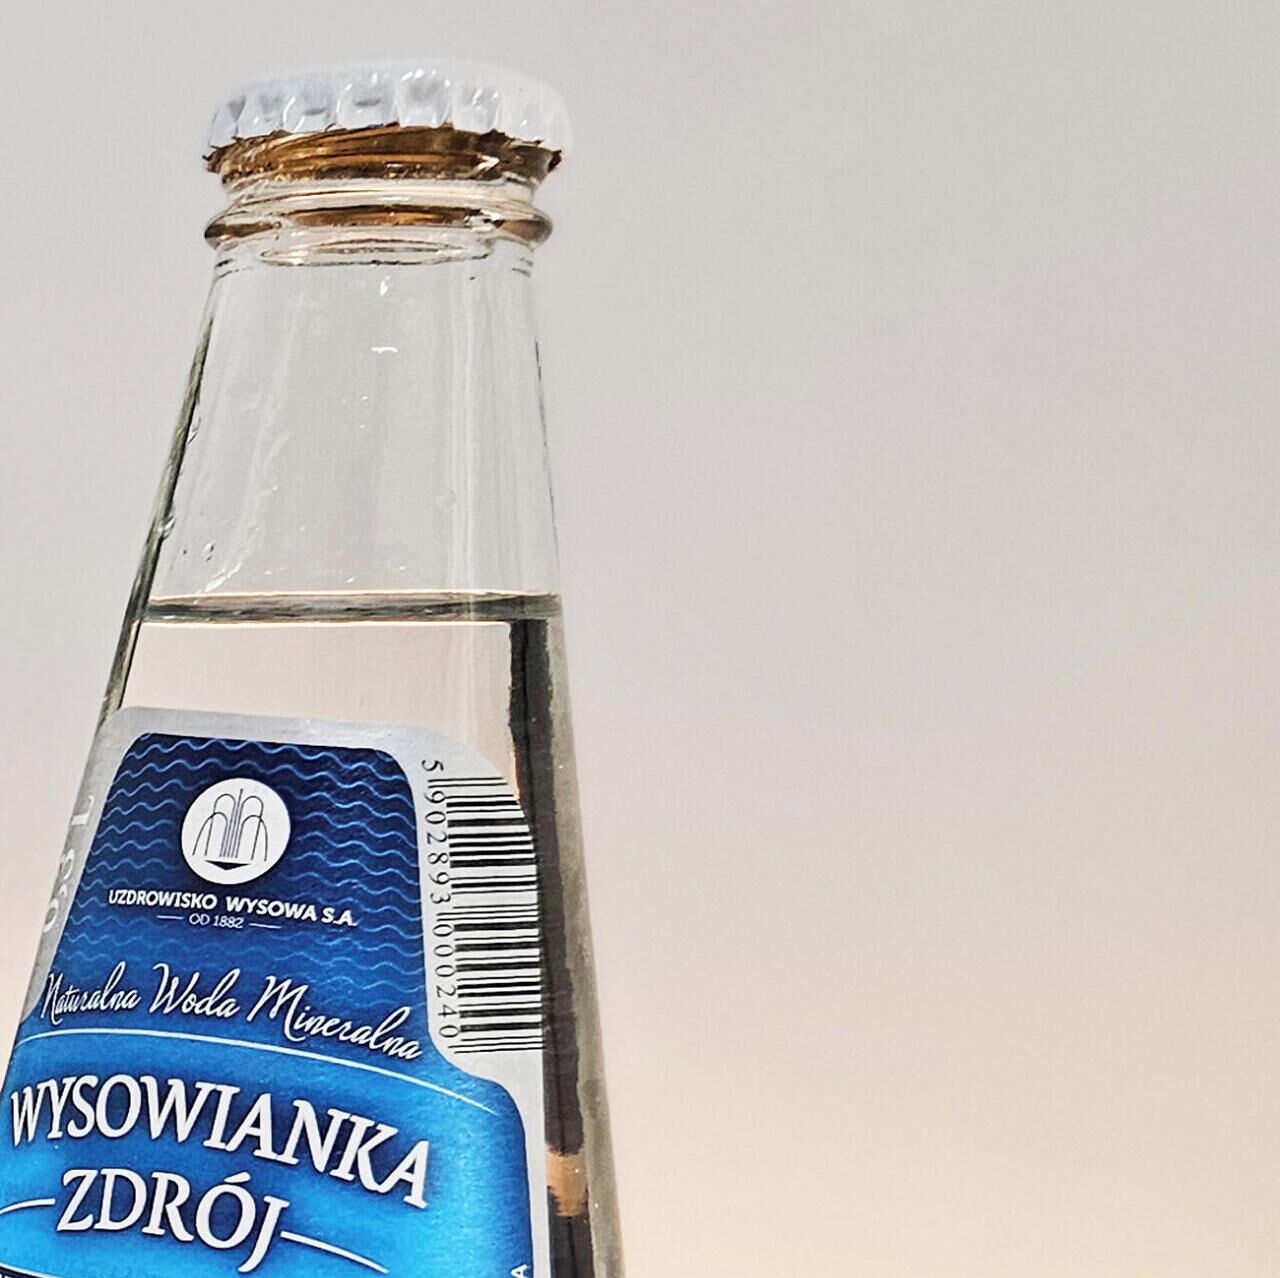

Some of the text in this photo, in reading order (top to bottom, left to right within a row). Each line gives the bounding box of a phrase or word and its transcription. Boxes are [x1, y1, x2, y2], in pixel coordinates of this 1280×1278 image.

[108, 889, 358, 926] UZDROWISKO WYSOWA S.A.
[189, 913, 244, 928] OD 1882
[41, 961, 423, 1061] Naturalna Woda Mineralna
[11, 1074, 430, 1210] WYSOWIANKA
[56, 1169, 290, 1273] ZDRÓJ
